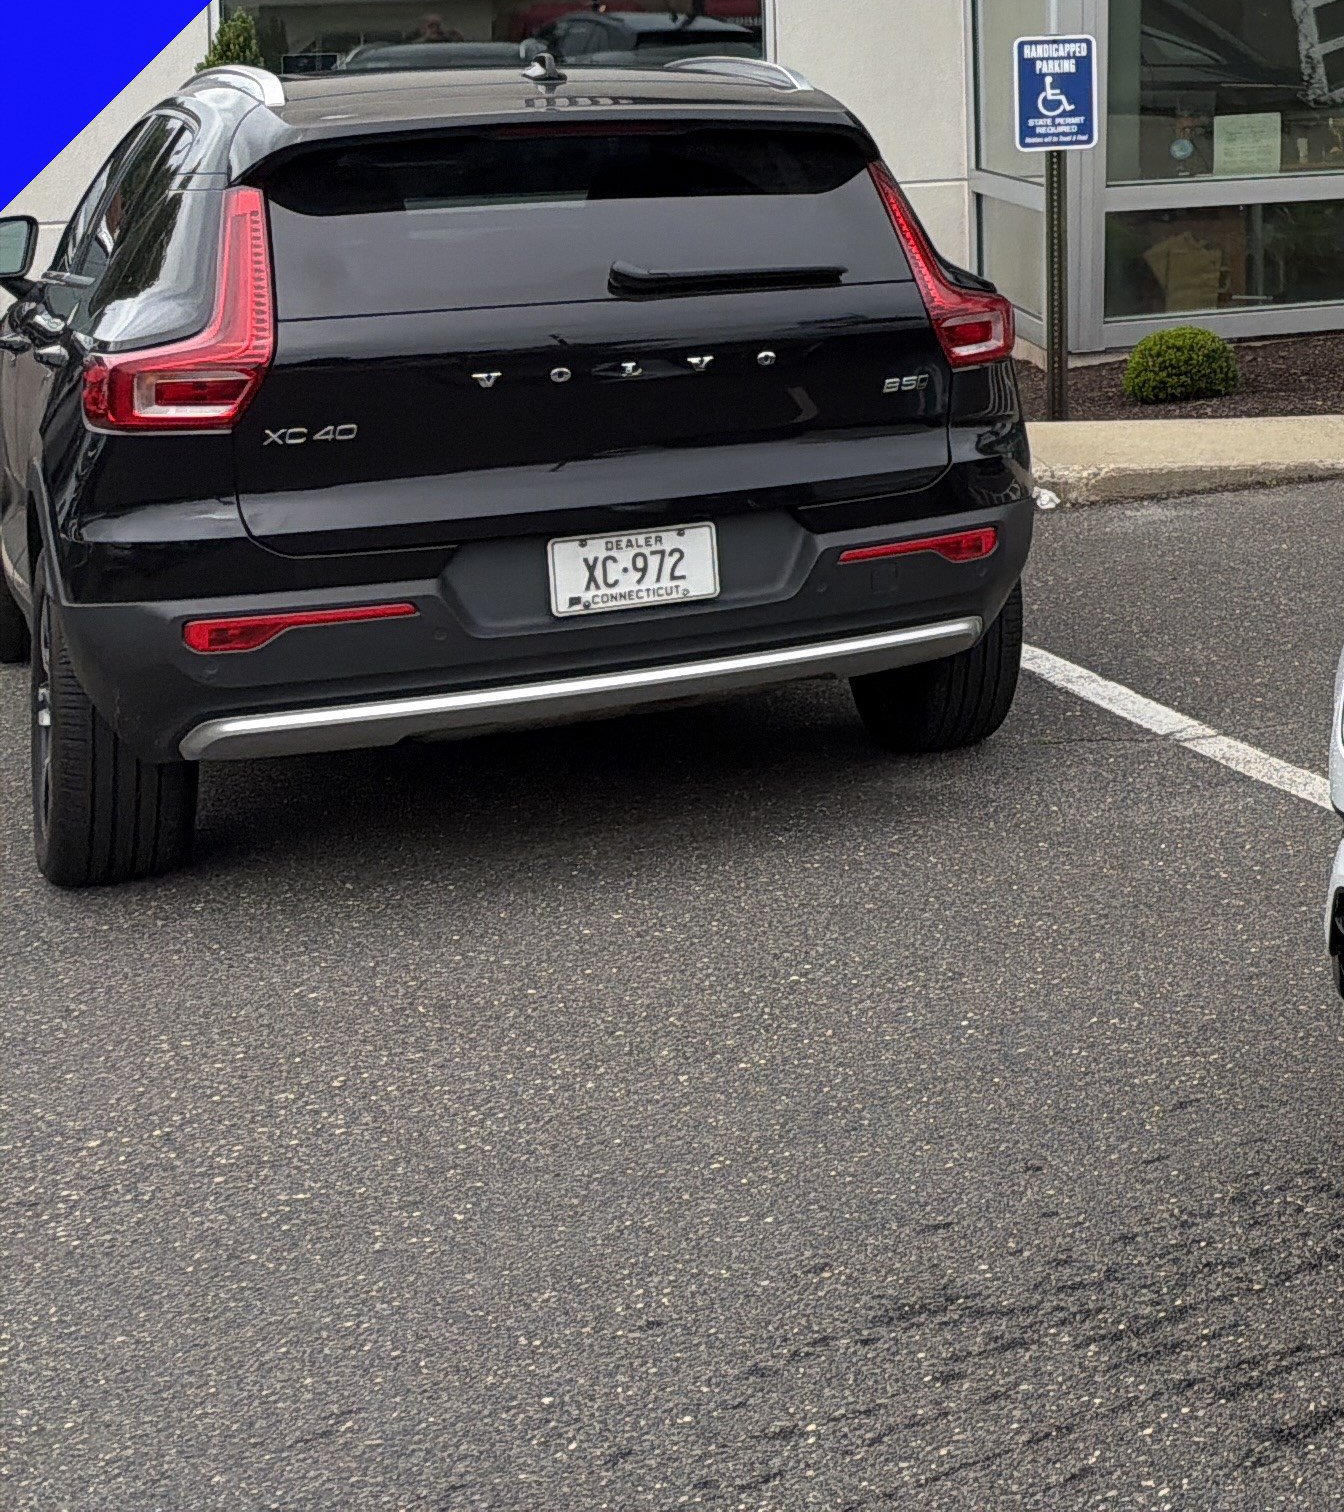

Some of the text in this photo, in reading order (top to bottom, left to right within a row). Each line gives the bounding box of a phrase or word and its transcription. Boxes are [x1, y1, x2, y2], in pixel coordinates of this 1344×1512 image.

[1023, 43, 1087, 59] HANDICAPPED
[1036, 59, 1076, 74] PARKING
[1027, 116, 1085, 127] STATE PERMIT
[1036, 125, 1078, 134] REQUIRED
[471, 350, 777, 388] VOLVO
[605, 536, 664, 552] DEALER
[591, 585, 681, 605] CONNECTICUT
